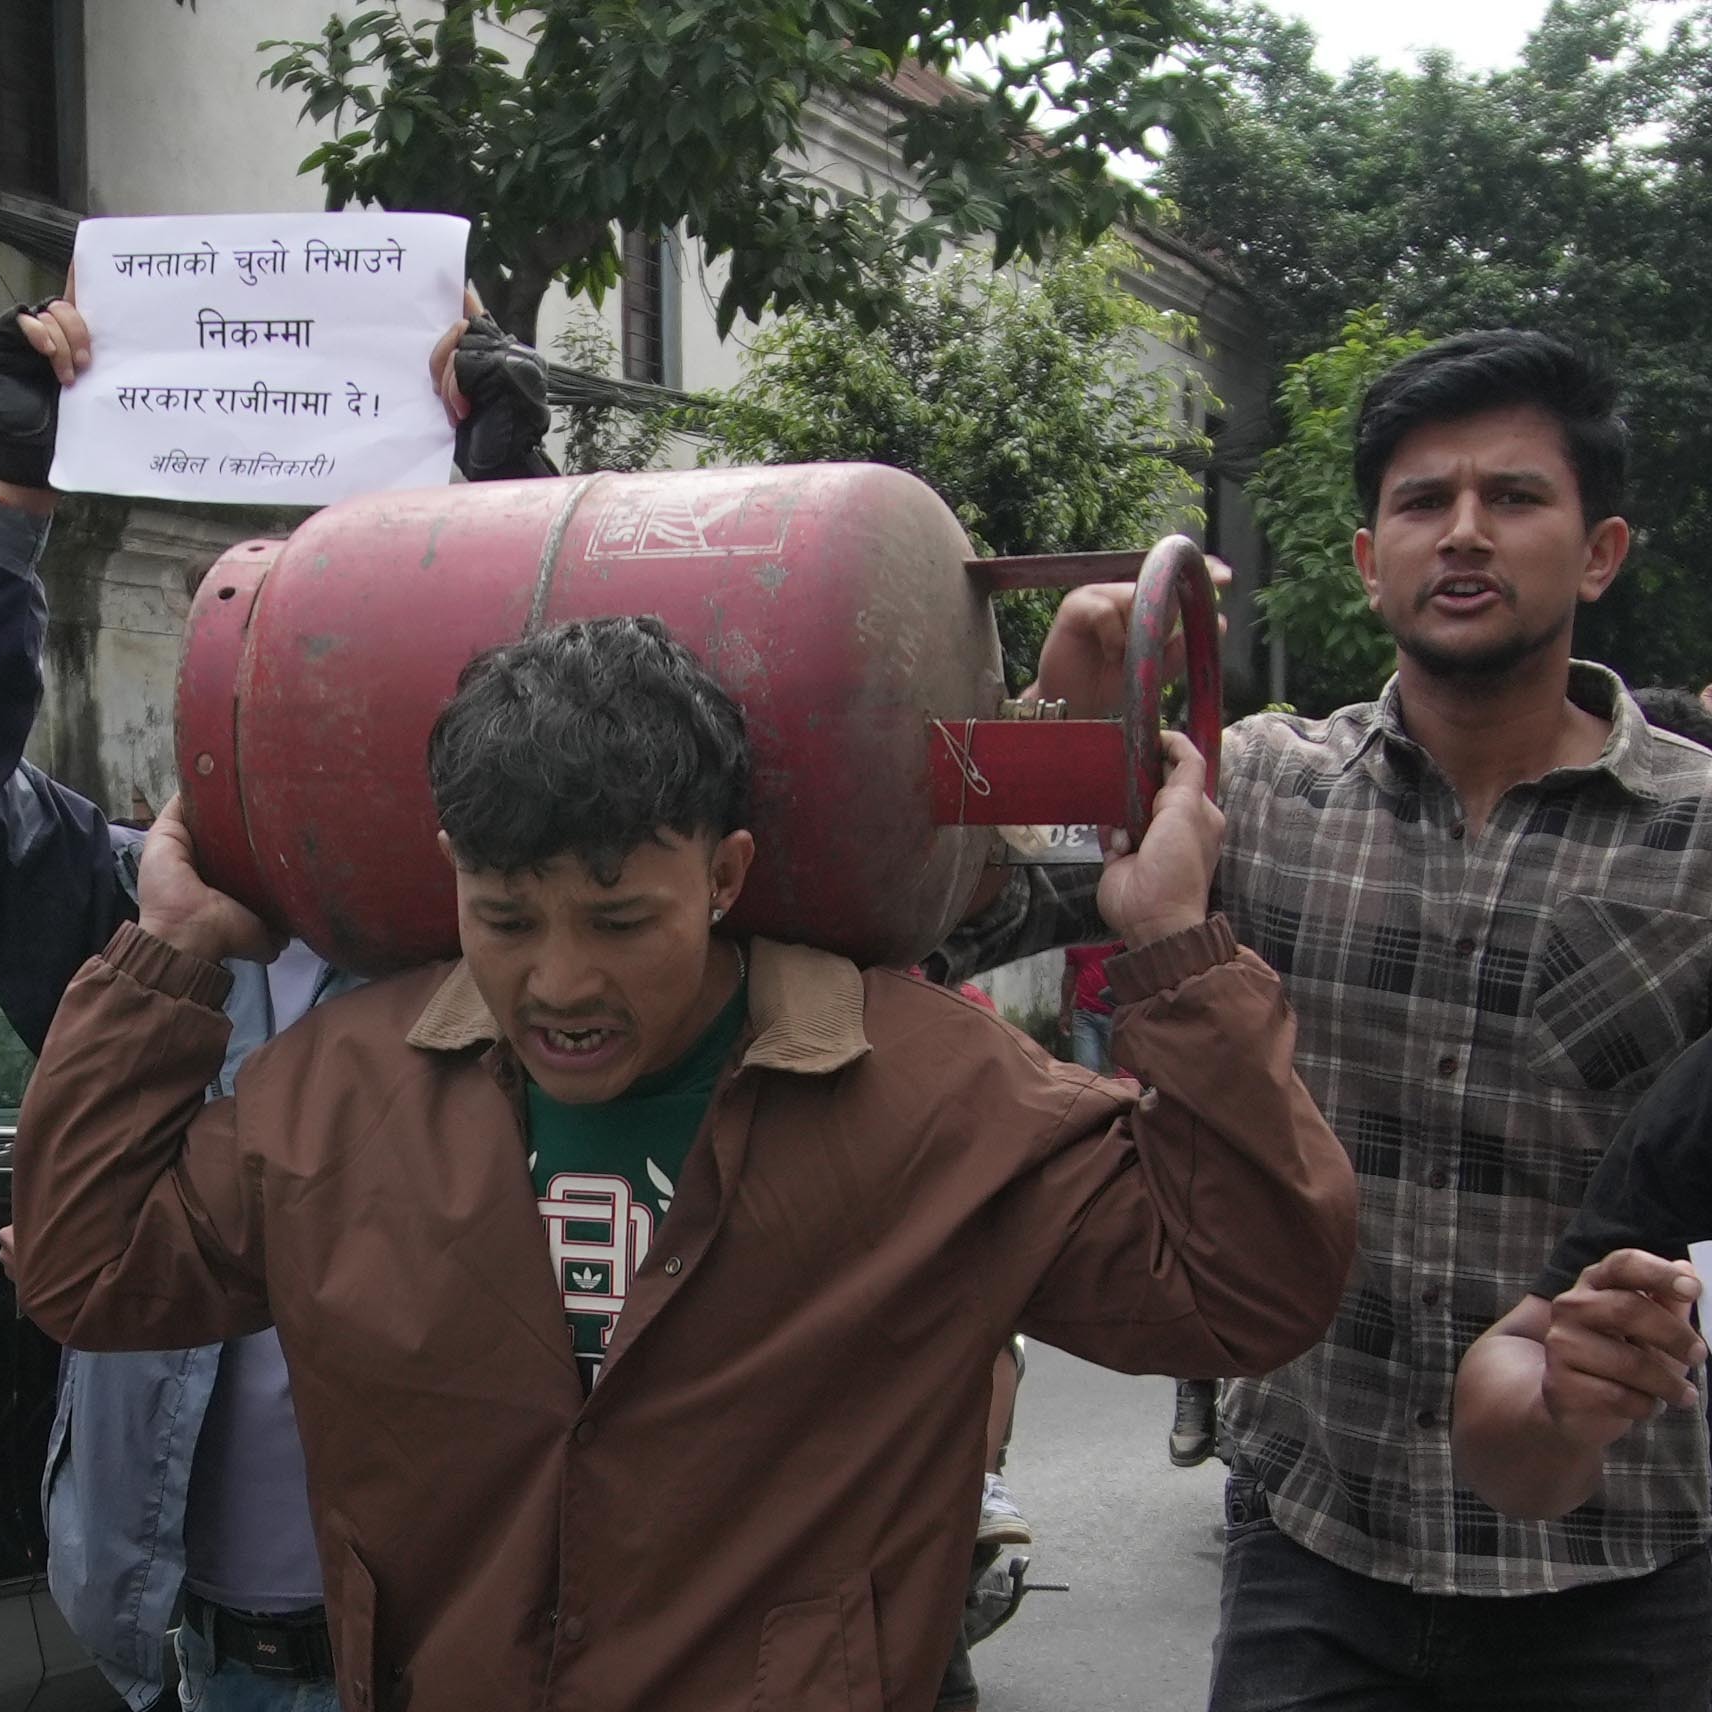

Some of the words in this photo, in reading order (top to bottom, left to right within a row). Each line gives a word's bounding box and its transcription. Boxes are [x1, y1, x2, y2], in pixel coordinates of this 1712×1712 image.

[112, 242, 219, 278] जनताको
[234, 240, 289, 286] चुलो
[304, 238, 407, 274] निभाउने
[196, 308, 315, 348] निकम्मा
[116, 386, 209, 413] सरकार
[212, 381, 332, 417] राजीनामा
[149, 448, 209, 474] अखिल
[219, 454, 336, 478] (क्रान्तिकारी)
